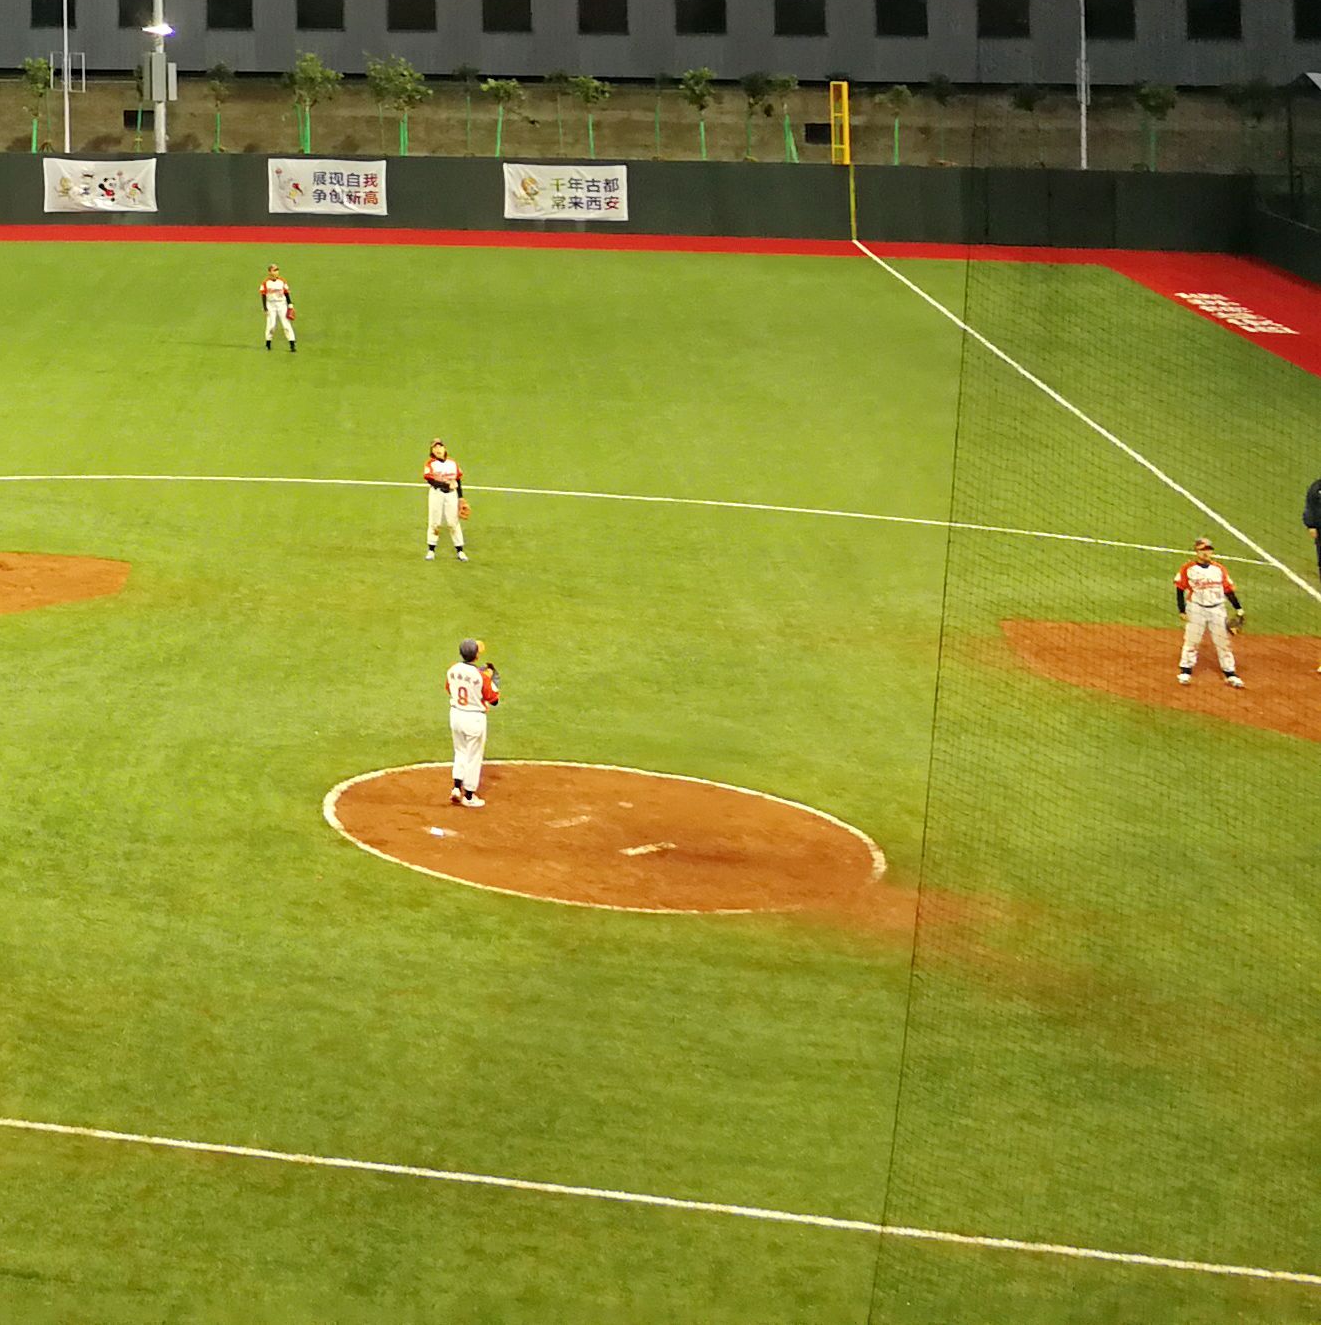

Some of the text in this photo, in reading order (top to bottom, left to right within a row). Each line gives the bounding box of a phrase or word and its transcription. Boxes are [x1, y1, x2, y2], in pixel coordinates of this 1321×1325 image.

[313, 171, 379, 187] 展现自我
[551, 177, 619, 193] 千年古都
[312, 188, 379, 205] 争创新高
[551, 195, 619, 211] 常来西安
